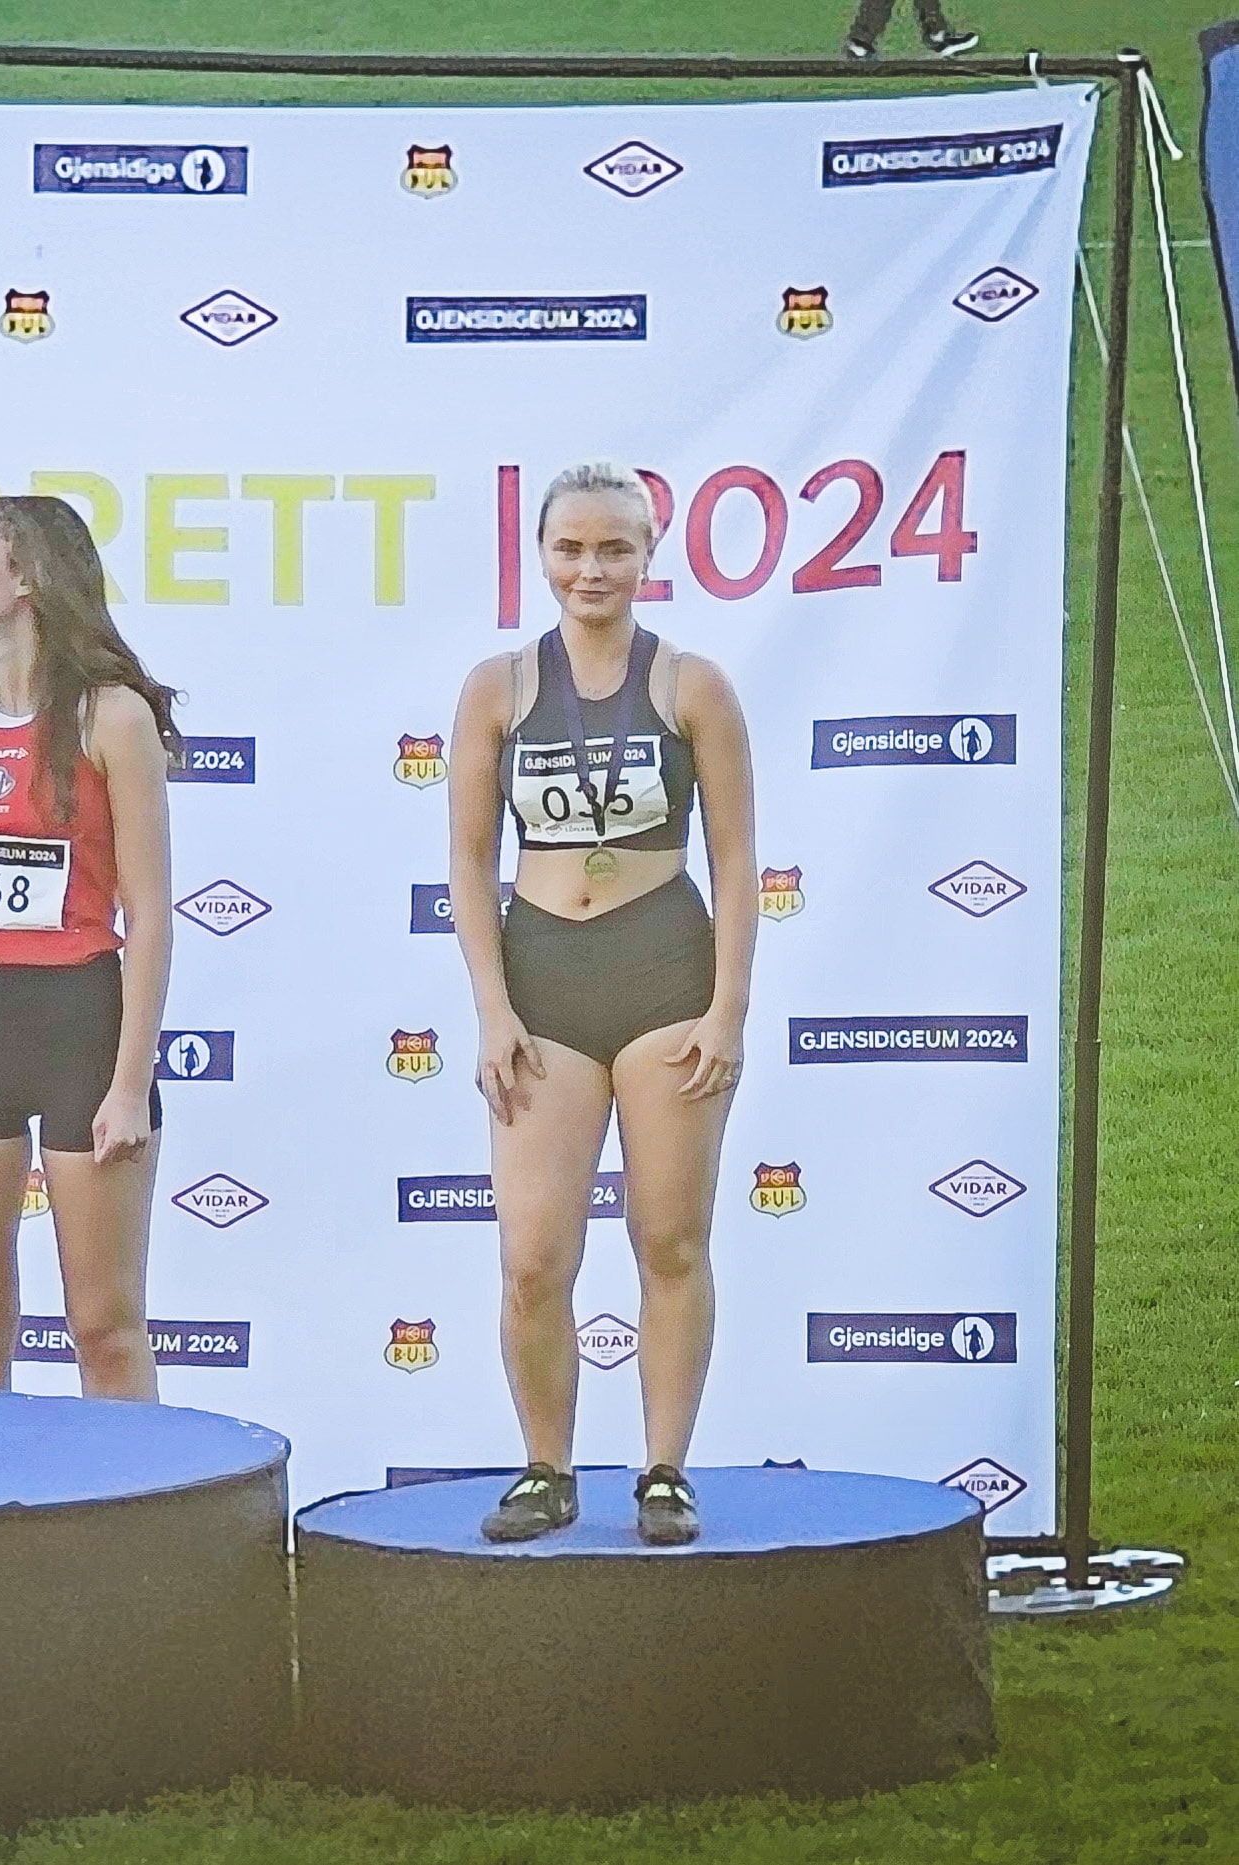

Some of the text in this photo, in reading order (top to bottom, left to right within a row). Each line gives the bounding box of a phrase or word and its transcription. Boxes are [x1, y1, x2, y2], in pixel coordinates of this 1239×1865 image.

[55, 156, 177, 184] Gjensidige
[583, 308, 638, 329] 2024
[831, 728, 943, 757] Gjensidige
[192, 750, 245, 770] 2024
[524, 748, 648, 770] GJENSIDIUM 024
[29, 850, 57, 862] 2024
[949, 881, 1008, 896] VIDAR
[194, 901, 252, 915] VIDAR
[799, 1029, 1018, 1050] GJENSIDIGEUM 2024
[408, 1186, 618, 1209] GJENSID 24
[949, 1181, 1007, 1195] VIDAR
[192, 1193, 249, 1208] VIDAR
[187, 1334, 240, 1354] 2024
[577, 1333, 635, 1349] VIDAR
[829, 1325, 945, 1352] Gjensidige
